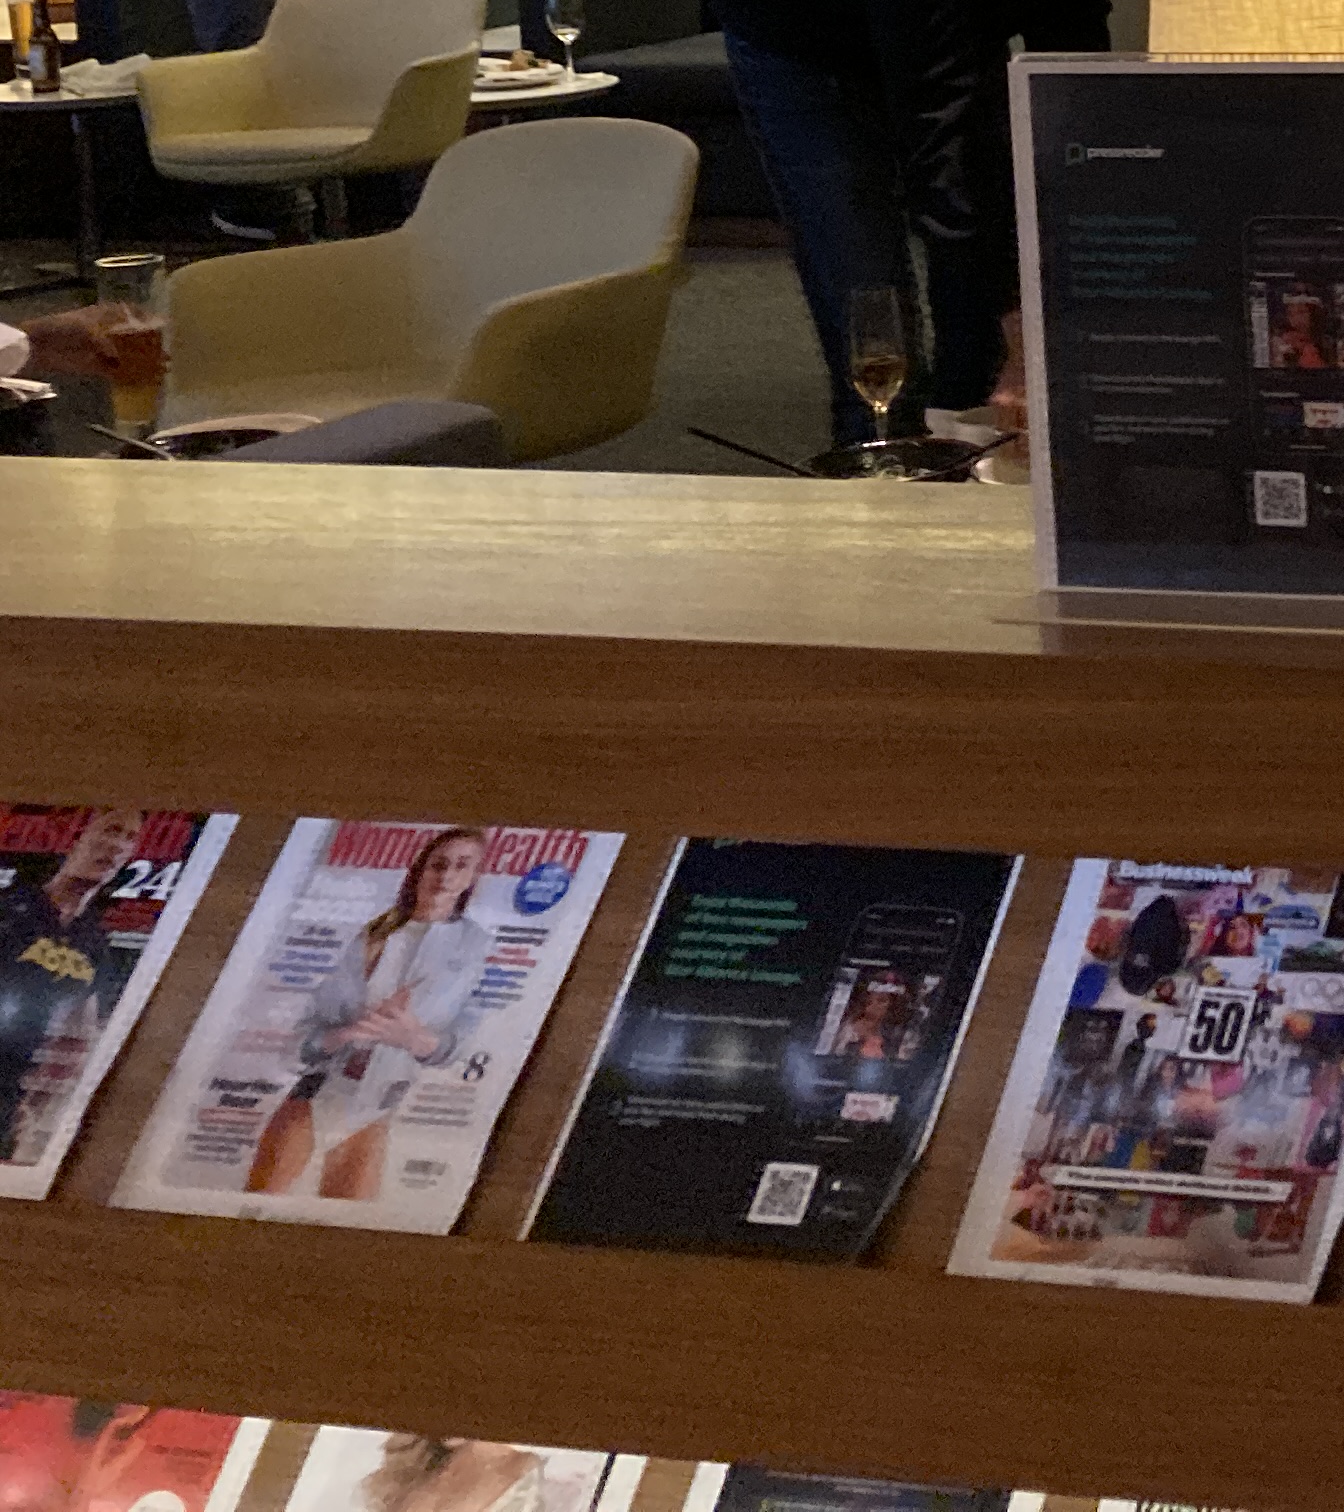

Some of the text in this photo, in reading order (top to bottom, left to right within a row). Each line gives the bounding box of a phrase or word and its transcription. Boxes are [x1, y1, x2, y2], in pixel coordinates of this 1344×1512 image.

[111, 859, 183, 901] 24
[1189, 999, 1245, 1054] 50
[463, 1051, 491, 1082] 8
